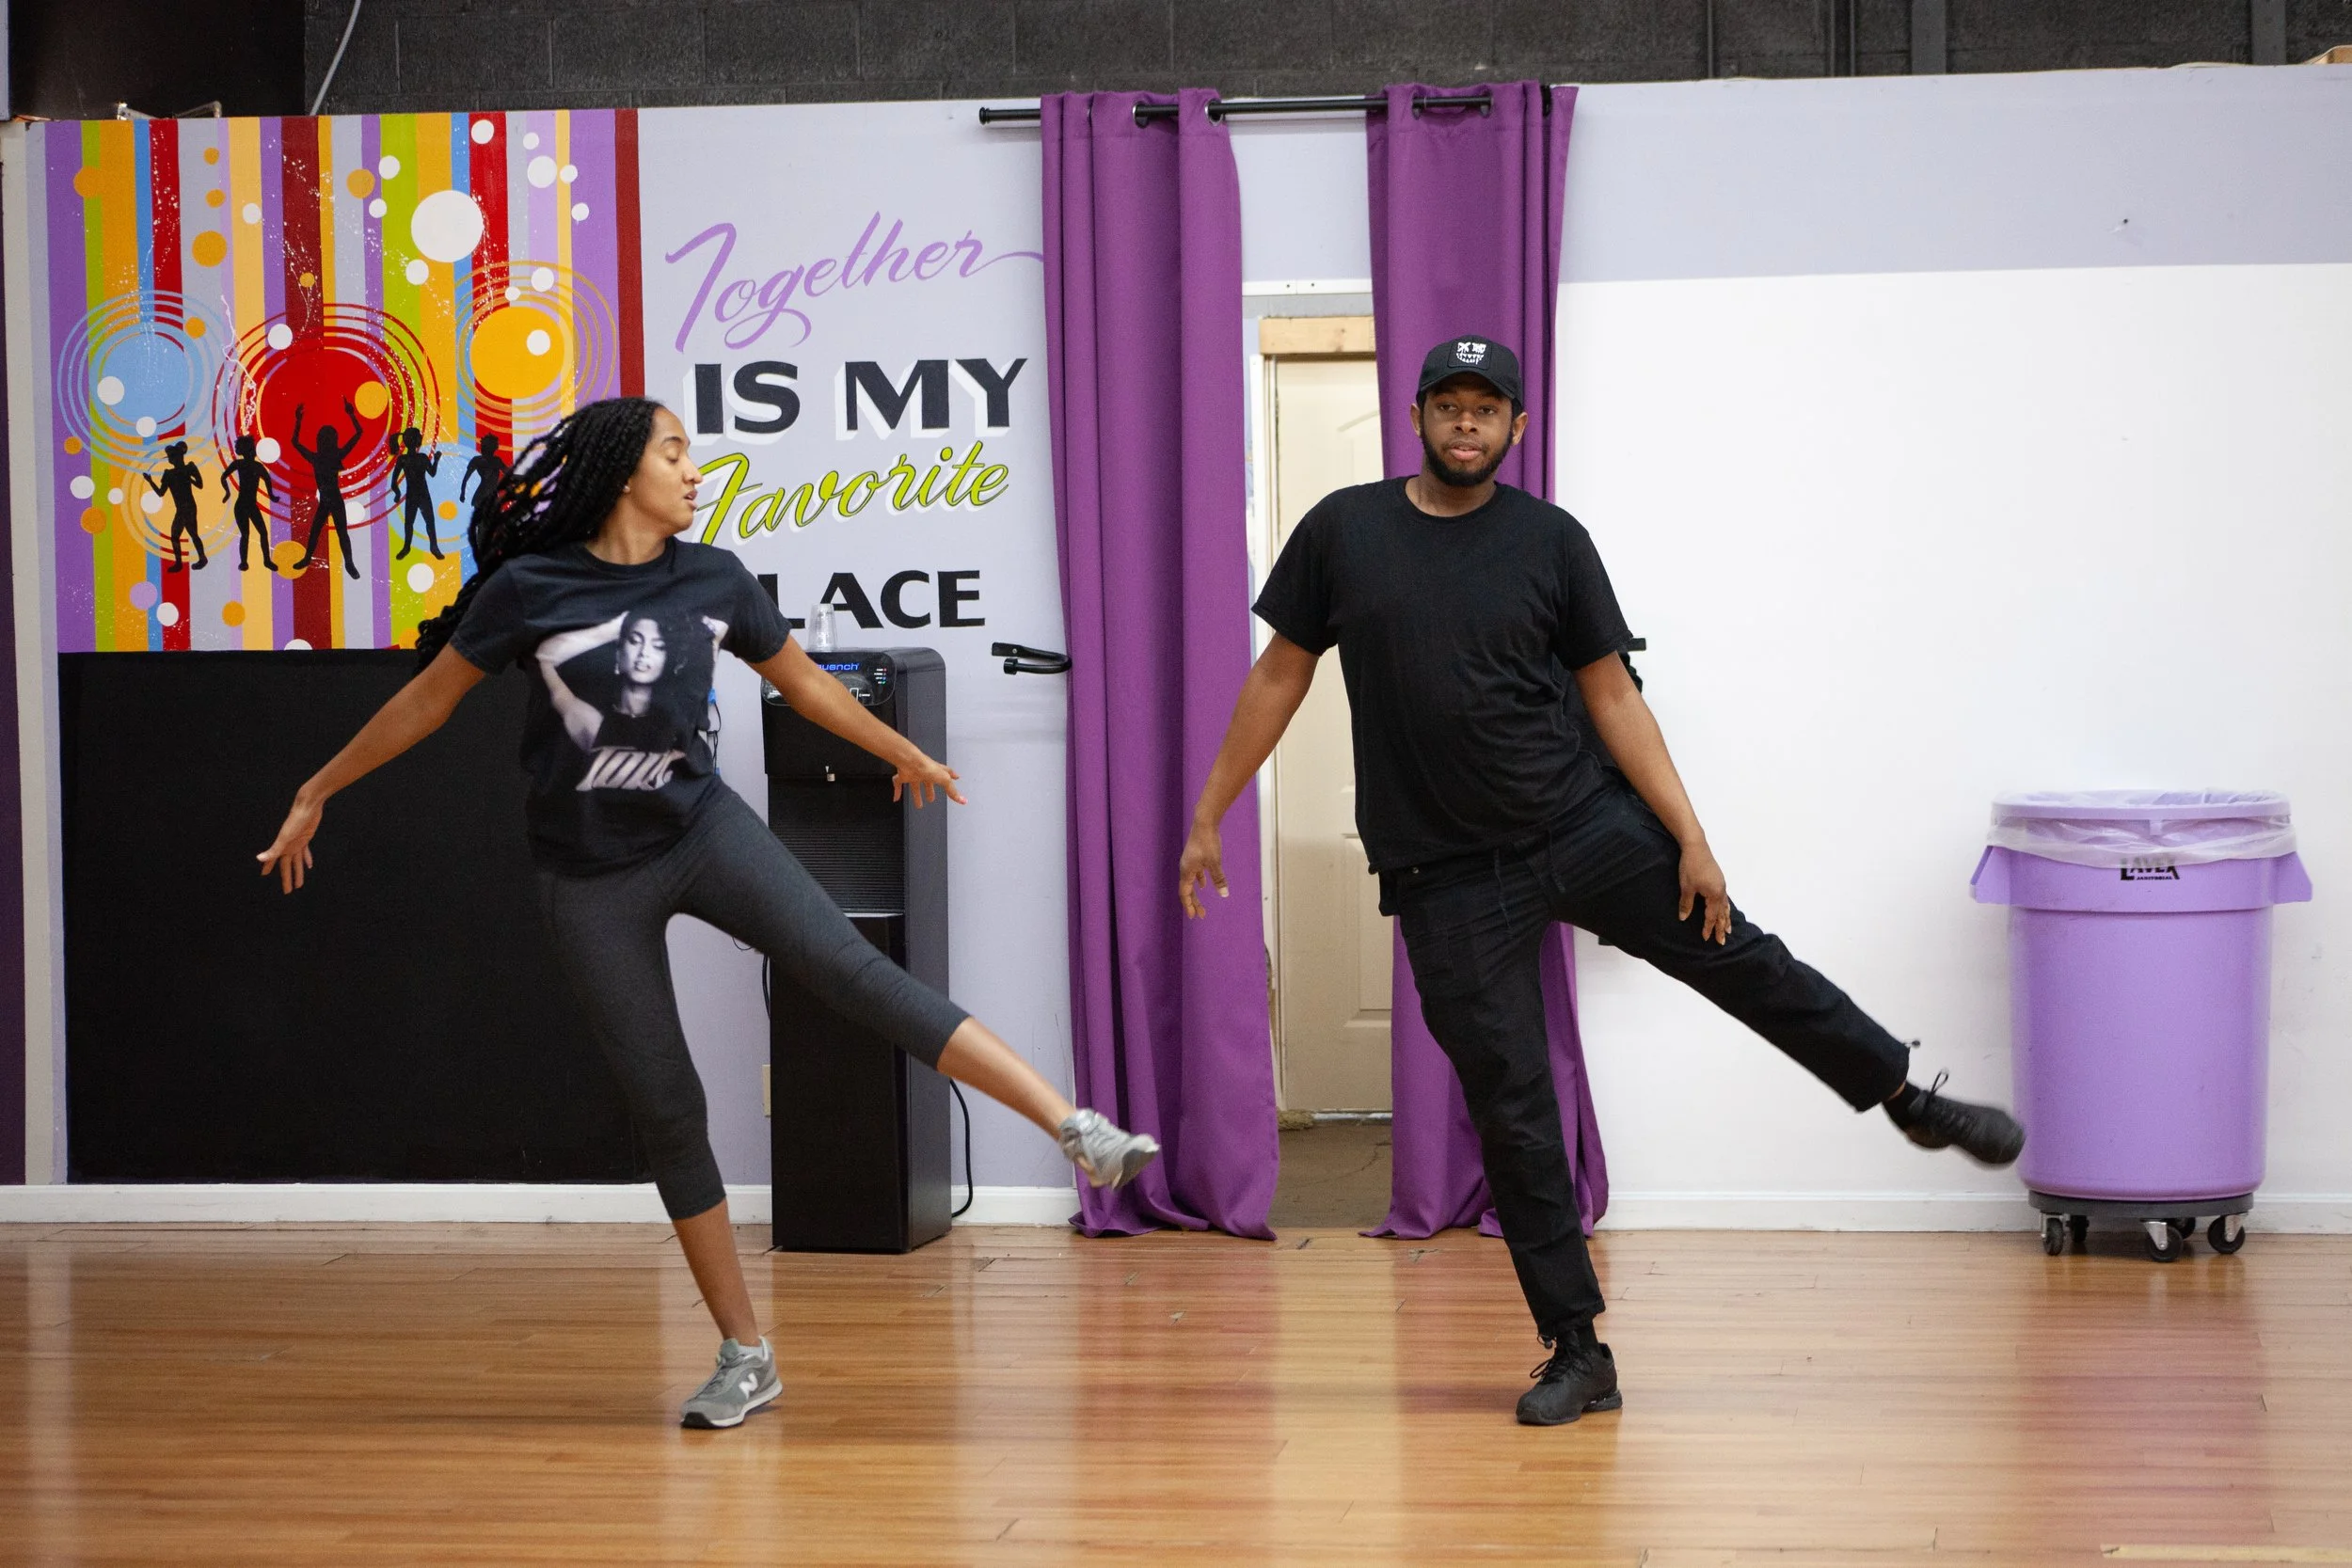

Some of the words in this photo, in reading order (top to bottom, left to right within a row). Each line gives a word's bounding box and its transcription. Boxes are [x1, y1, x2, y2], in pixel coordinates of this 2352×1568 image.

[665, 211, 1043, 353] Together
[691, 360, 801, 438] IS
[842, 357, 1028, 434] MY
[697, 440, 1009, 546] Favorite
[757, 570, 986, 629] LACE
[817, 662, 858, 671] uench
